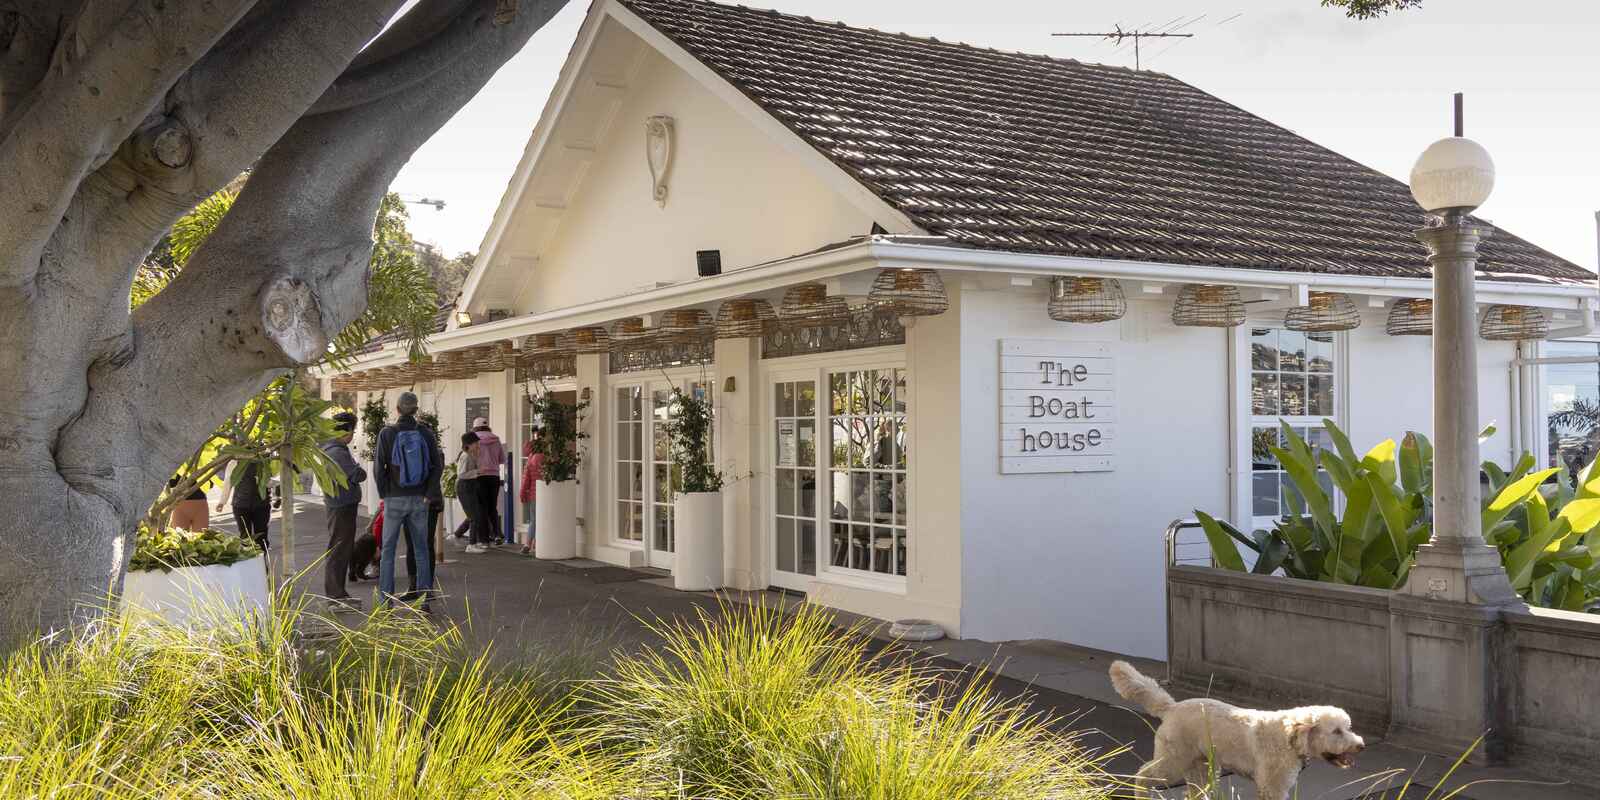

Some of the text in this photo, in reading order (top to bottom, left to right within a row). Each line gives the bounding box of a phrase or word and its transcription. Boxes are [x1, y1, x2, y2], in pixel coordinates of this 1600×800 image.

[1039, 360, 1088, 386] The
[1028, 395, 1095, 419] Boat
[1020, 427, 1101, 452] house
